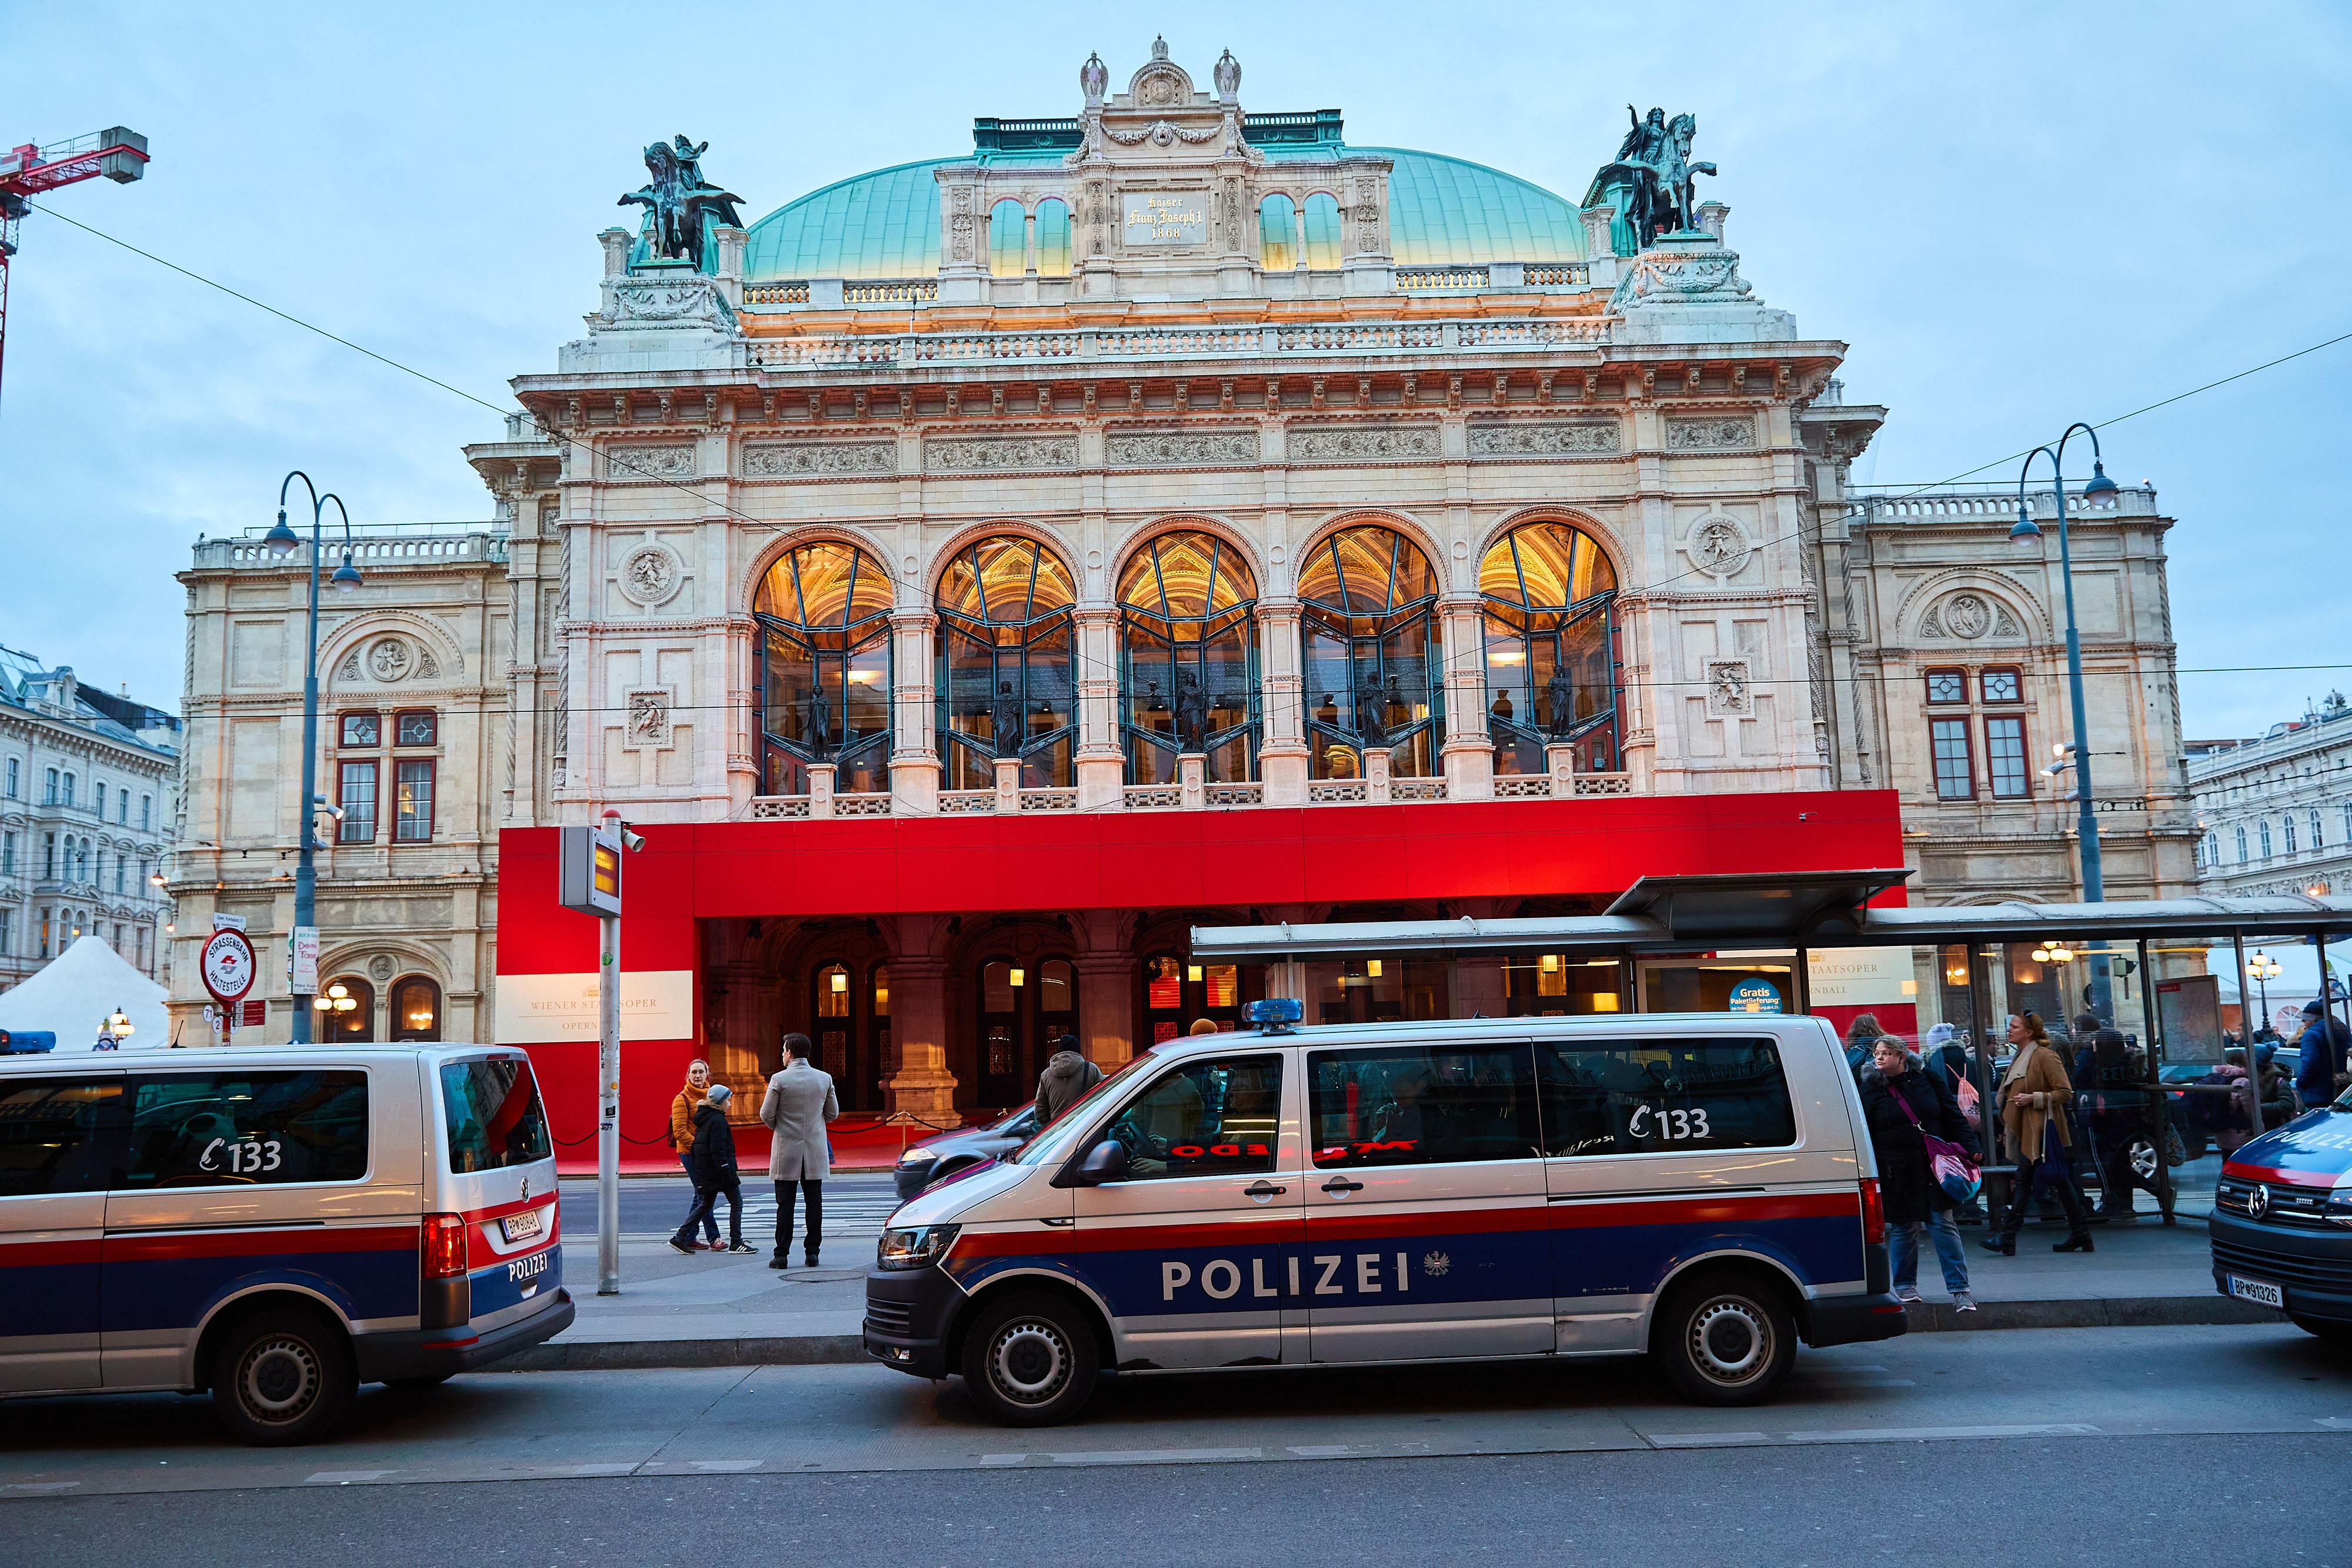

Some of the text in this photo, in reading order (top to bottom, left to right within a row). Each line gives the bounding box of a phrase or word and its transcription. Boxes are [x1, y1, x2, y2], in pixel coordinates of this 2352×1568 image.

[1148, 197, 1183, 210] Kaiser
[1127, 209, 1157, 228] Franz
[1158, 209, 1195, 228] Joseph
[1151, 227, 1181, 240] 1868
[209, 937, 250, 963] STRASSENBAHN
[1810, 964, 1878, 974] TAATSOPER
[209, 969, 247, 992] HALTESTELLE
[1740, 987, 1770, 997] Gratis
[205, 1008, 213, 1018] 71
[531, 999, 657, 1010] WIENER STASOPER
[215, 1019, 220, 1030] 2
[1655, 1108, 1710, 1139] 133
[2264, 1131, 2352, 1152] POLIZE
[228, 1141, 281, 1172] 133
[508, 1219, 517, 1234] BP
[507, 1252, 547, 1282] POLIZEI
[1162, 1252, 1409, 1300] POLIZEI
[2234, 1279, 2277, 1303] BP 91326
